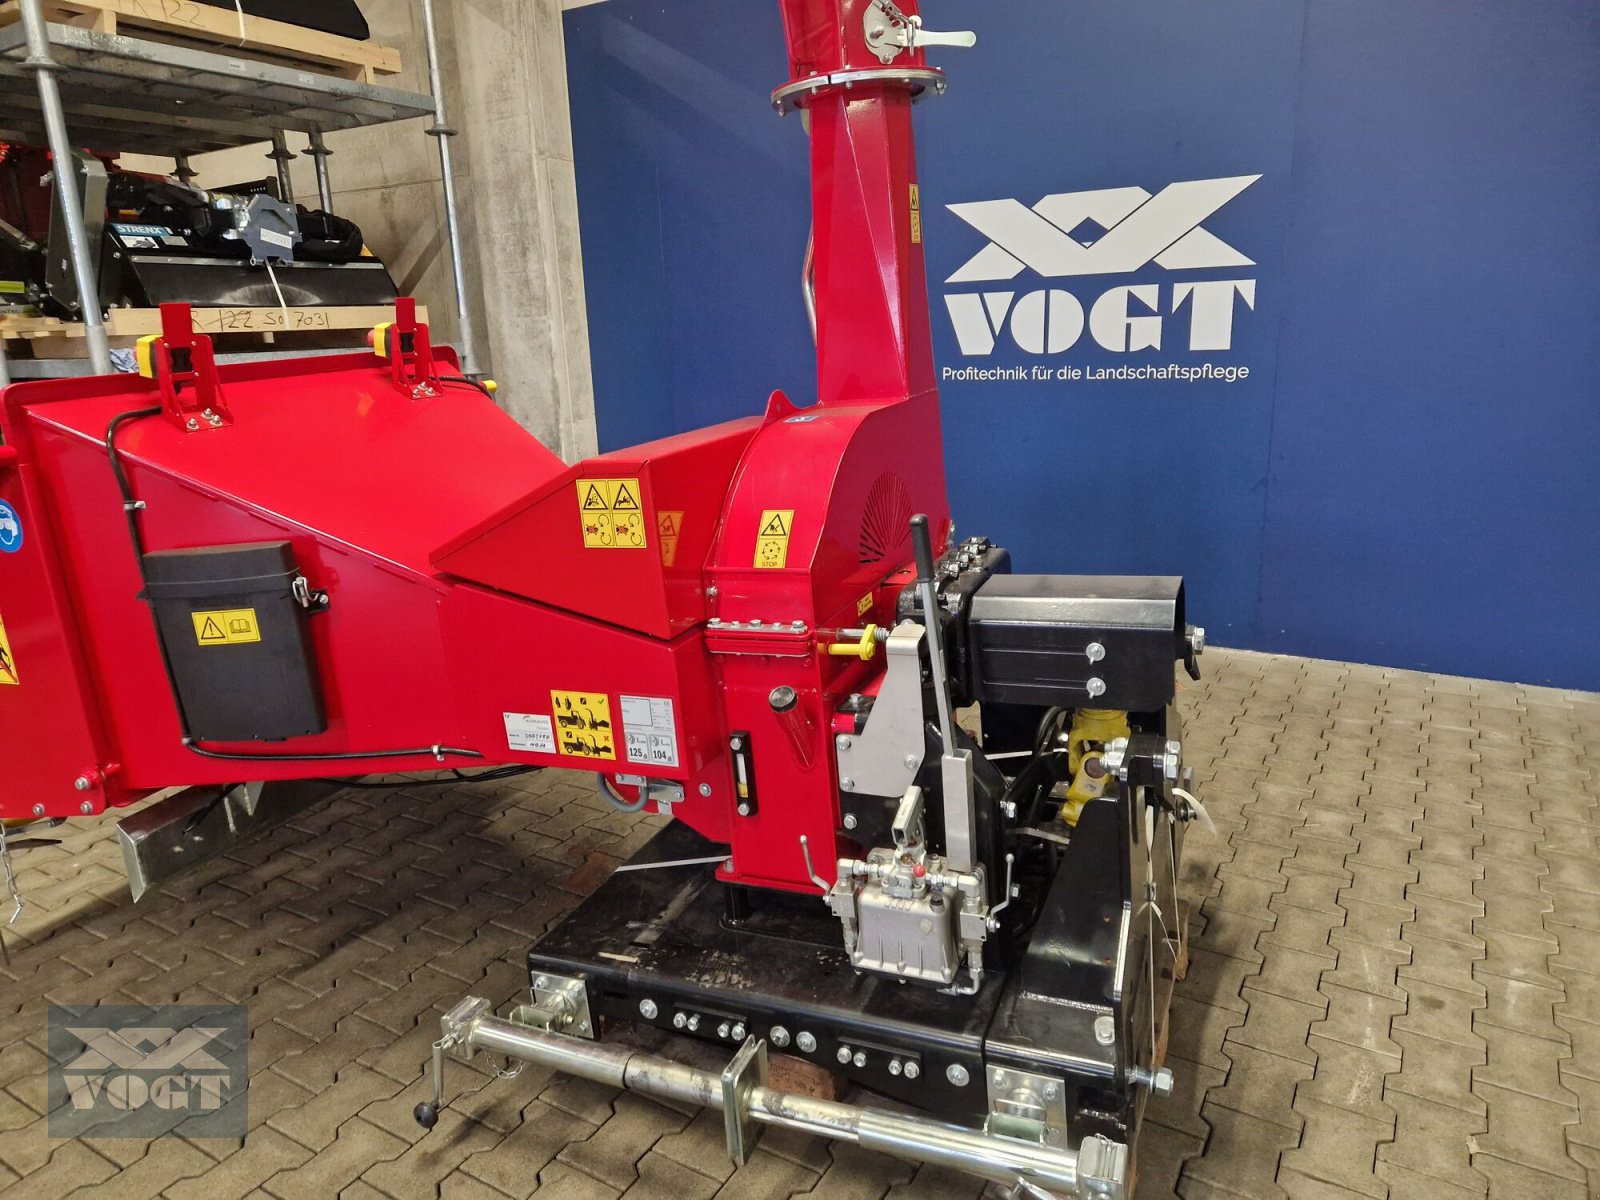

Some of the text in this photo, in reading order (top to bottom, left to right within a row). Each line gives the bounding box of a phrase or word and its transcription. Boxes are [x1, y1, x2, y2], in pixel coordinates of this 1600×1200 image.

[117, 225, 163, 235] STRENX
[943, 279, 1257, 356] VOGT
[942, 363, 1250, 383] Profitechnik für die Landschaftspflege
[629, 747, 643, 758] 125
[653, 750, 667, 760] 104
